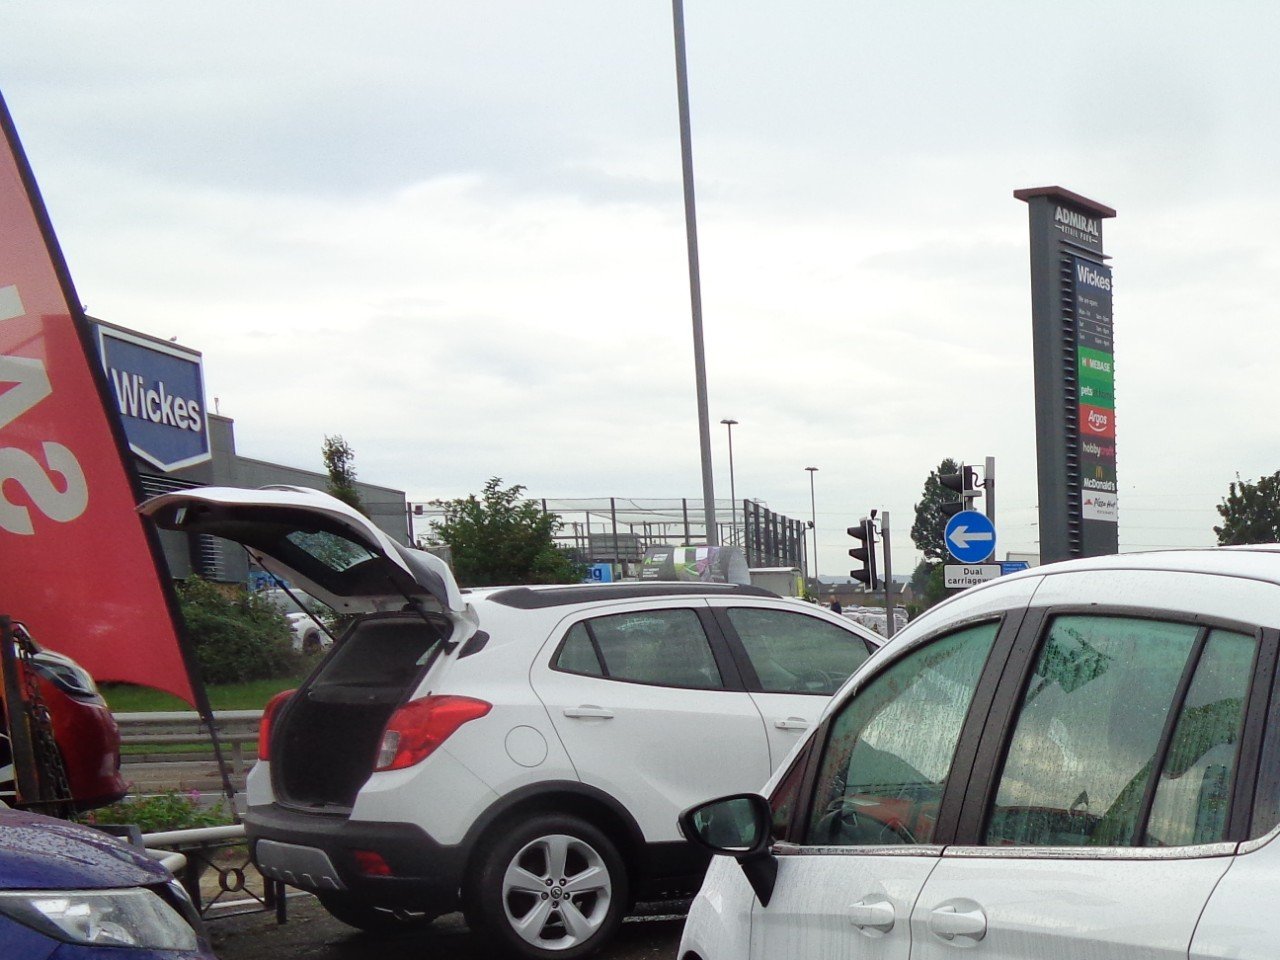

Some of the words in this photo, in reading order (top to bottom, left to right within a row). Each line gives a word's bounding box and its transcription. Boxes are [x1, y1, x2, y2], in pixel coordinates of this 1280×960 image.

[1054, 206, 1098, 236] ADMIRAL
[1077, 264, 1111, 291] Wickes
[111, 367, 201, 432] Wickes
[1088, 410, 1107, 426] Argos
[1083, 477, 1115, 491] McDonald's
[963, 567, 983, 576] Dual
